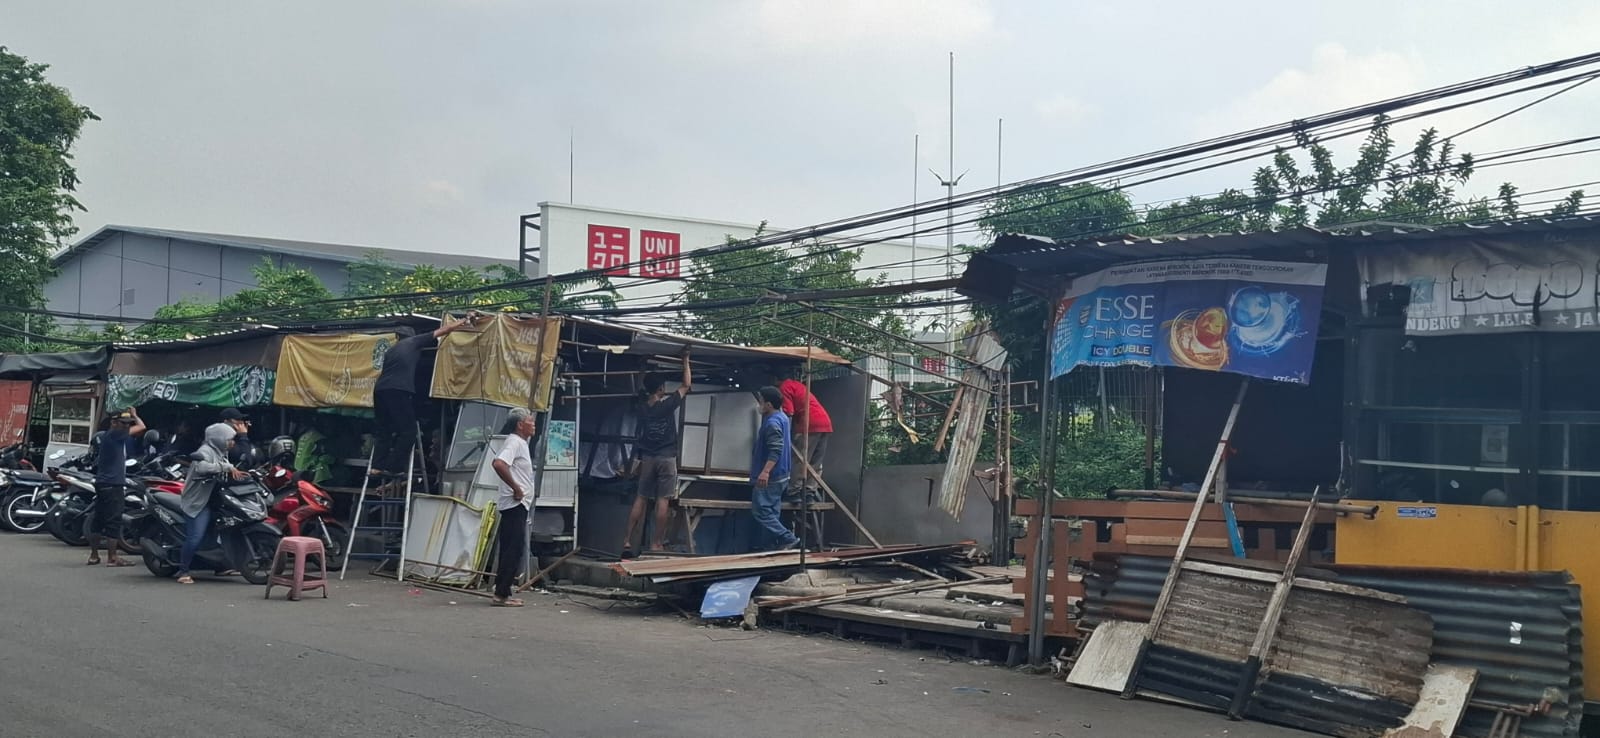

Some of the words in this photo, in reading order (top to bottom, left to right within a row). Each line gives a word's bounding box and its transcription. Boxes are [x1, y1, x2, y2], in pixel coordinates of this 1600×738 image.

[645, 237, 673, 256] UNI
[1095, 295, 1155, 322] ESSE
[1406, 316, 1460, 331] NDENG
[1574, 311, 1600, 329] JA
[1083, 323, 1153, 341] CHANGE
[1093, 347, 1110, 356] ICY
[1113, 346, 1151, 356] DOUBLE
